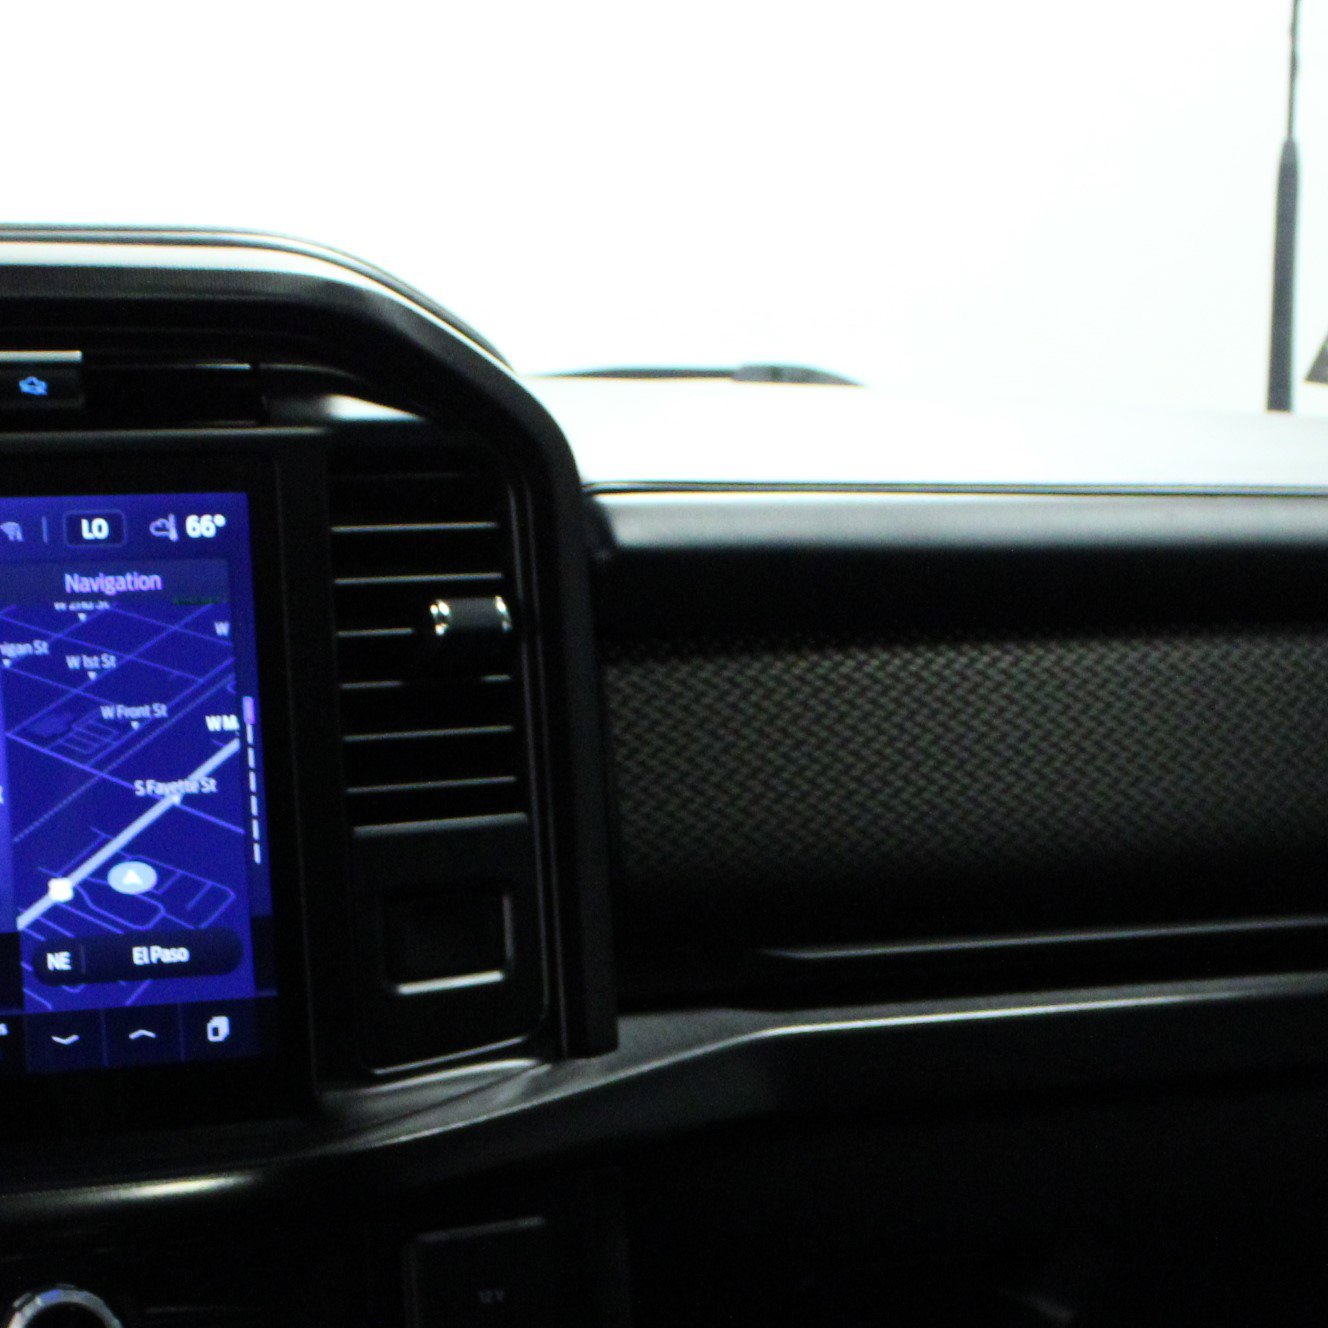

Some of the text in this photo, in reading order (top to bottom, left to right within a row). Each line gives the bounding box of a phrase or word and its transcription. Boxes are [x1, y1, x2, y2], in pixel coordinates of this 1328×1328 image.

[81, 517, 109, 540] LO
[185, 514, 226, 538] 66°
[65, 571, 162, 595] Navigation
[33, 640, 50, 655] St
[66, 655, 81, 670] W
[102, 652, 117, 668] St
[101, 702, 168, 720] W Front St
[134, 780, 146, 796] S
[200, 777, 218, 794] St
[46, 952, 72, 971] NE
[132, 945, 190, 965] El Paso
